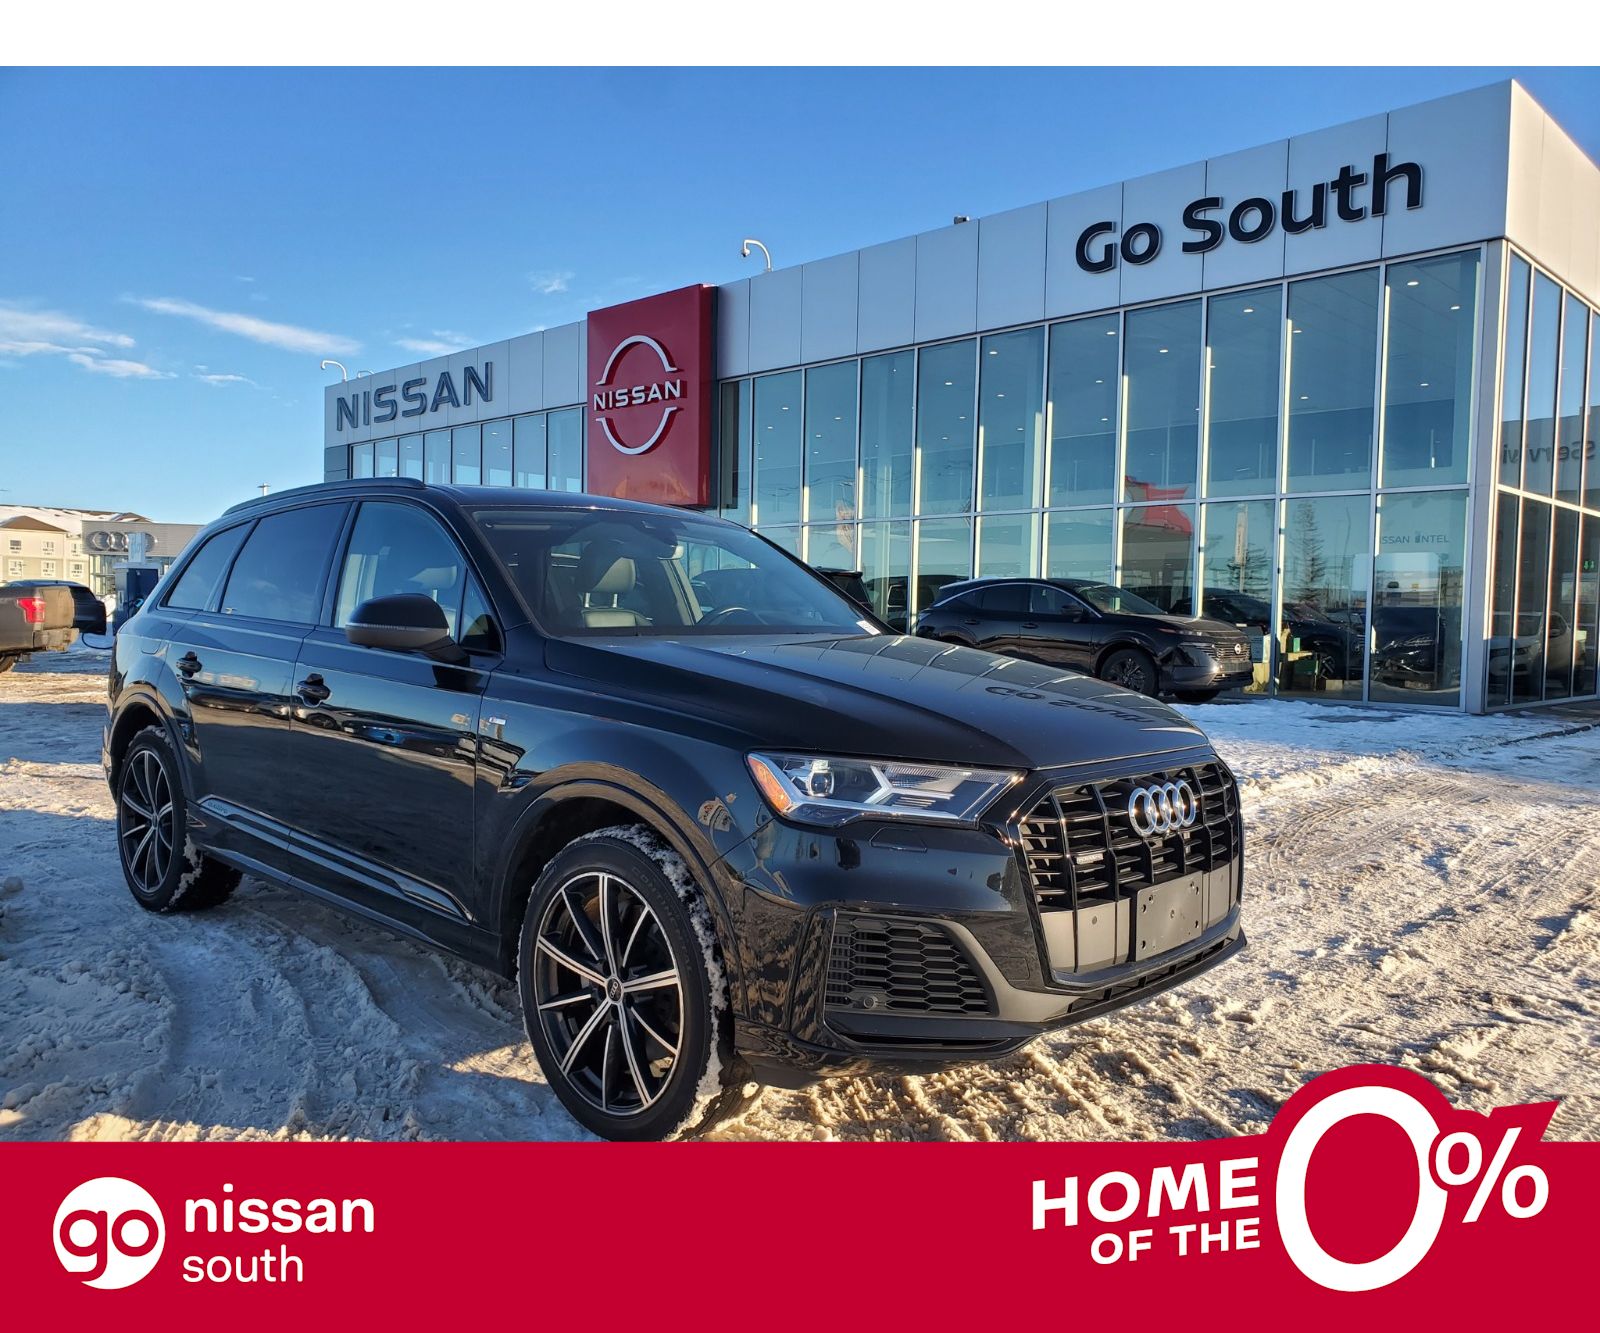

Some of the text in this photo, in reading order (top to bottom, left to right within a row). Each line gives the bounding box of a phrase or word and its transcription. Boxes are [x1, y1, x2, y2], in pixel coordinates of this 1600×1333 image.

[1075, 152, 1424, 274] Go South
[336, 361, 493, 431] NISSAN
[593, 378, 682, 411] NISSAN
